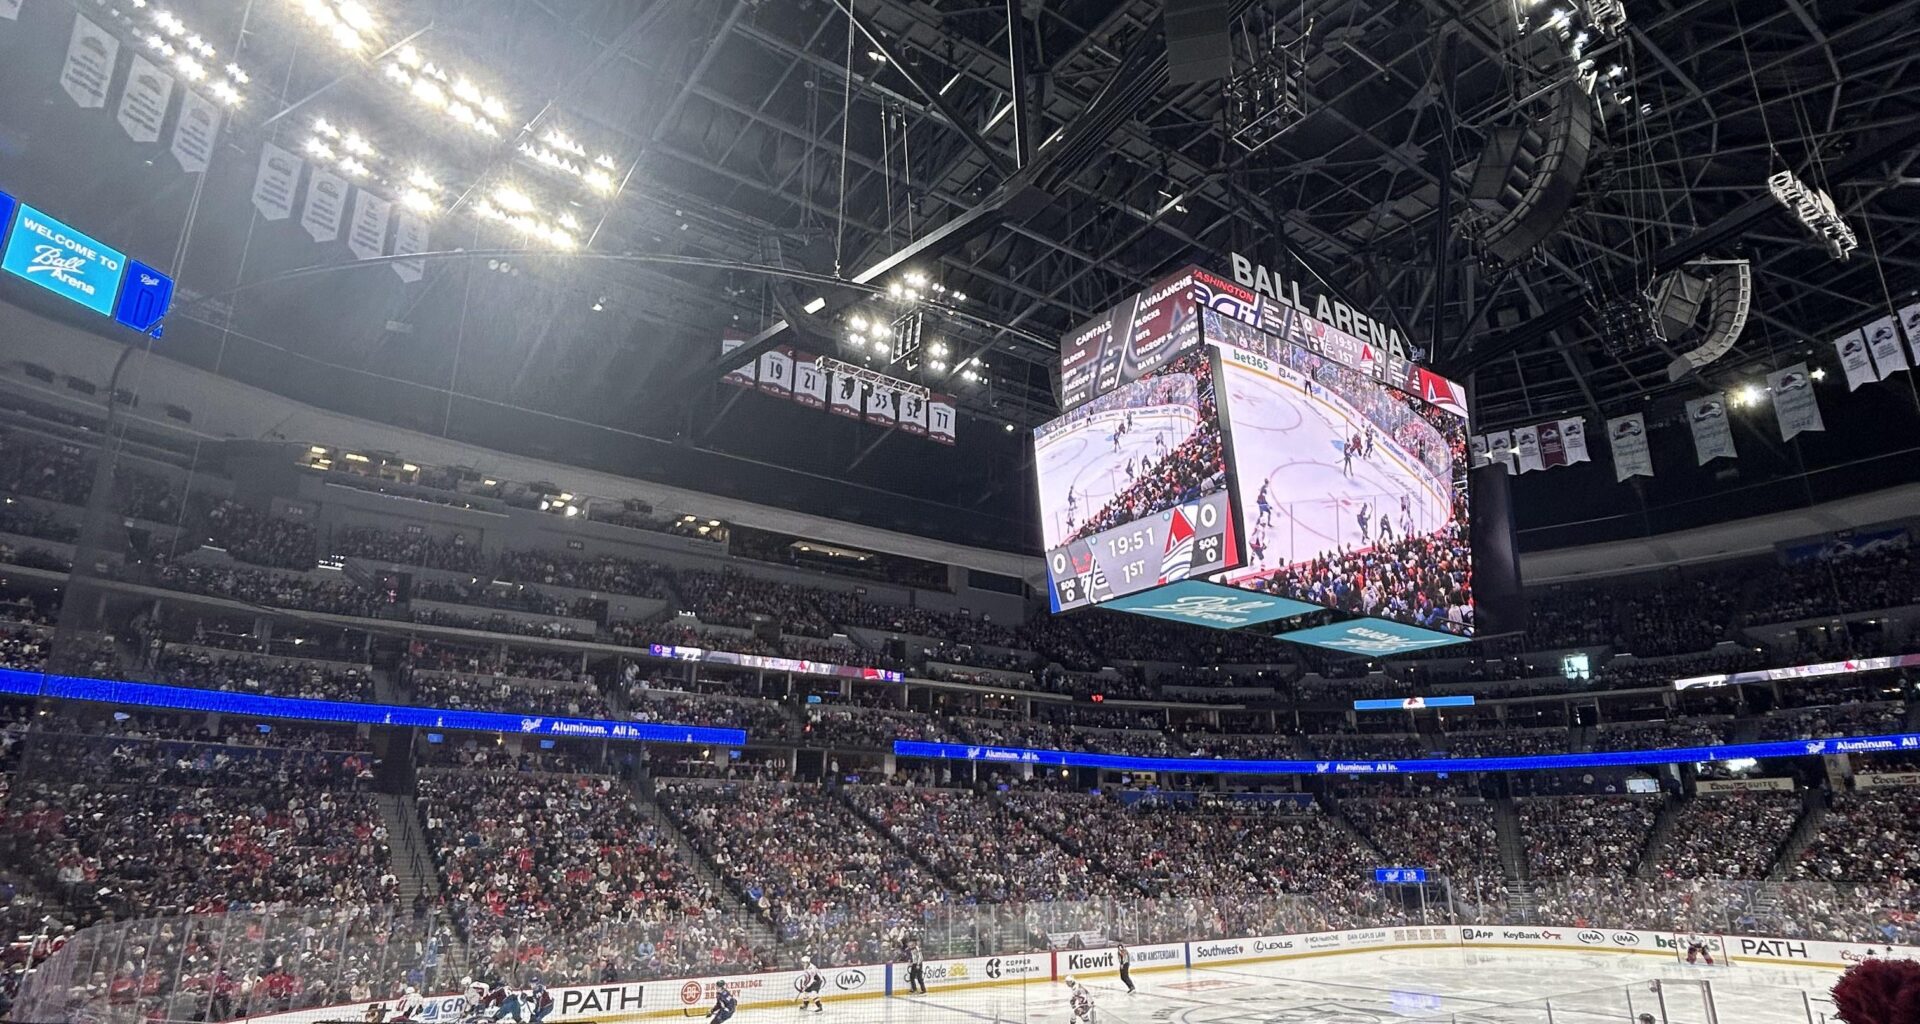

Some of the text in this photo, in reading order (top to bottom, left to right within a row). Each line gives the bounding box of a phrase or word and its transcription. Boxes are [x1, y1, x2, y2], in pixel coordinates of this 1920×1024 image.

[24, 217, 118, 271] WELCOME TO
[30, 244, 86, 274] Ball
[50, 269, 95, 296] Arena
[140, 273, 160, 287] Ball
[1193, 269, 1255, 303] ASHINGTON
[1138, 275, 1193, 311] AVALANCHE
[1135, 291, 1194, 328] BLOCKS 0
[1231, 251, 1407, 362] BALL ARENA
[1135, 306, 1194, 342] HITS 0
[1304, 317, 1312, 331] 0
[1076, 320, 1112, 347] CAPITALS
[1063, 335, 1113, 366] BLOCKS 0
[1333, 334, 1358, 354] 19:51
[1137, 356, 1155, 371] SAVE
[1180, 337, 1197, 350] .000
[1233, 349, 1269, 371] bet365
[1338, 349, 1354, 364] 1ST
[1374, 350, 1382, 363] 0
[770, 361, 782, 380] 19
[804, 372, 816, 391] 21
[875, 393, 887, 410] 33
[907, 402, 919, 419] 52
[936, 411, 948, 429] 77
[1200, 504, 1217, 528] 0
[1108, 527, 1155, 558] 19:51
[1198, 536, 1218, 550] SOG
[1053, 553, 1066, 574] 0
[1205, 549, 1216, 562] 0
[1122, 560, 1145, 584] 1ST
[1060, 579, 1076, 591] SOG
[1066, 589, 1075, 602] 0
[520, 718, 640, 737] Ball Aluminum. All in.
[1837, 739, 1897, 751] Aluminum.
[1902, 736, 1918, 748] All
[984, 750, 1020, 761] Aluminum.
[1021, 752, 1030, 761] All
[1335, 763, 1374, 773] Aluminum.
[1376, 763, 1388, 771] All
[1388, 763, 1399, 772] in.
[1748, 781, 1780, 790] SUITES
[1503, 931, 1541, 941] KeyBank
[1582, 932, 1600, 941] IMA
[1616, 934, 1635, 943] IMA
[1655, 934, 1720, 952] bet5
[1197, 944, 1239, 958] Southwest
[1264, 940, 1293, 953] LEXUS
[1740, 938, 1809, 958] PATH
[1005, 958, 1031, 967] COPPER
[1068, 952, 1114, 970] Kiewit
[1137, 950, 1176, 962] NEW AMSTERDAM
[841, 975, 861, 985] IMA
[904, 964, 947, 983] Sfside
[705, 980, 763, 992] BRKENRIDGE
[705, 989, 741, 1000] BRRY
[562, 985, 645, 1015] PATH
